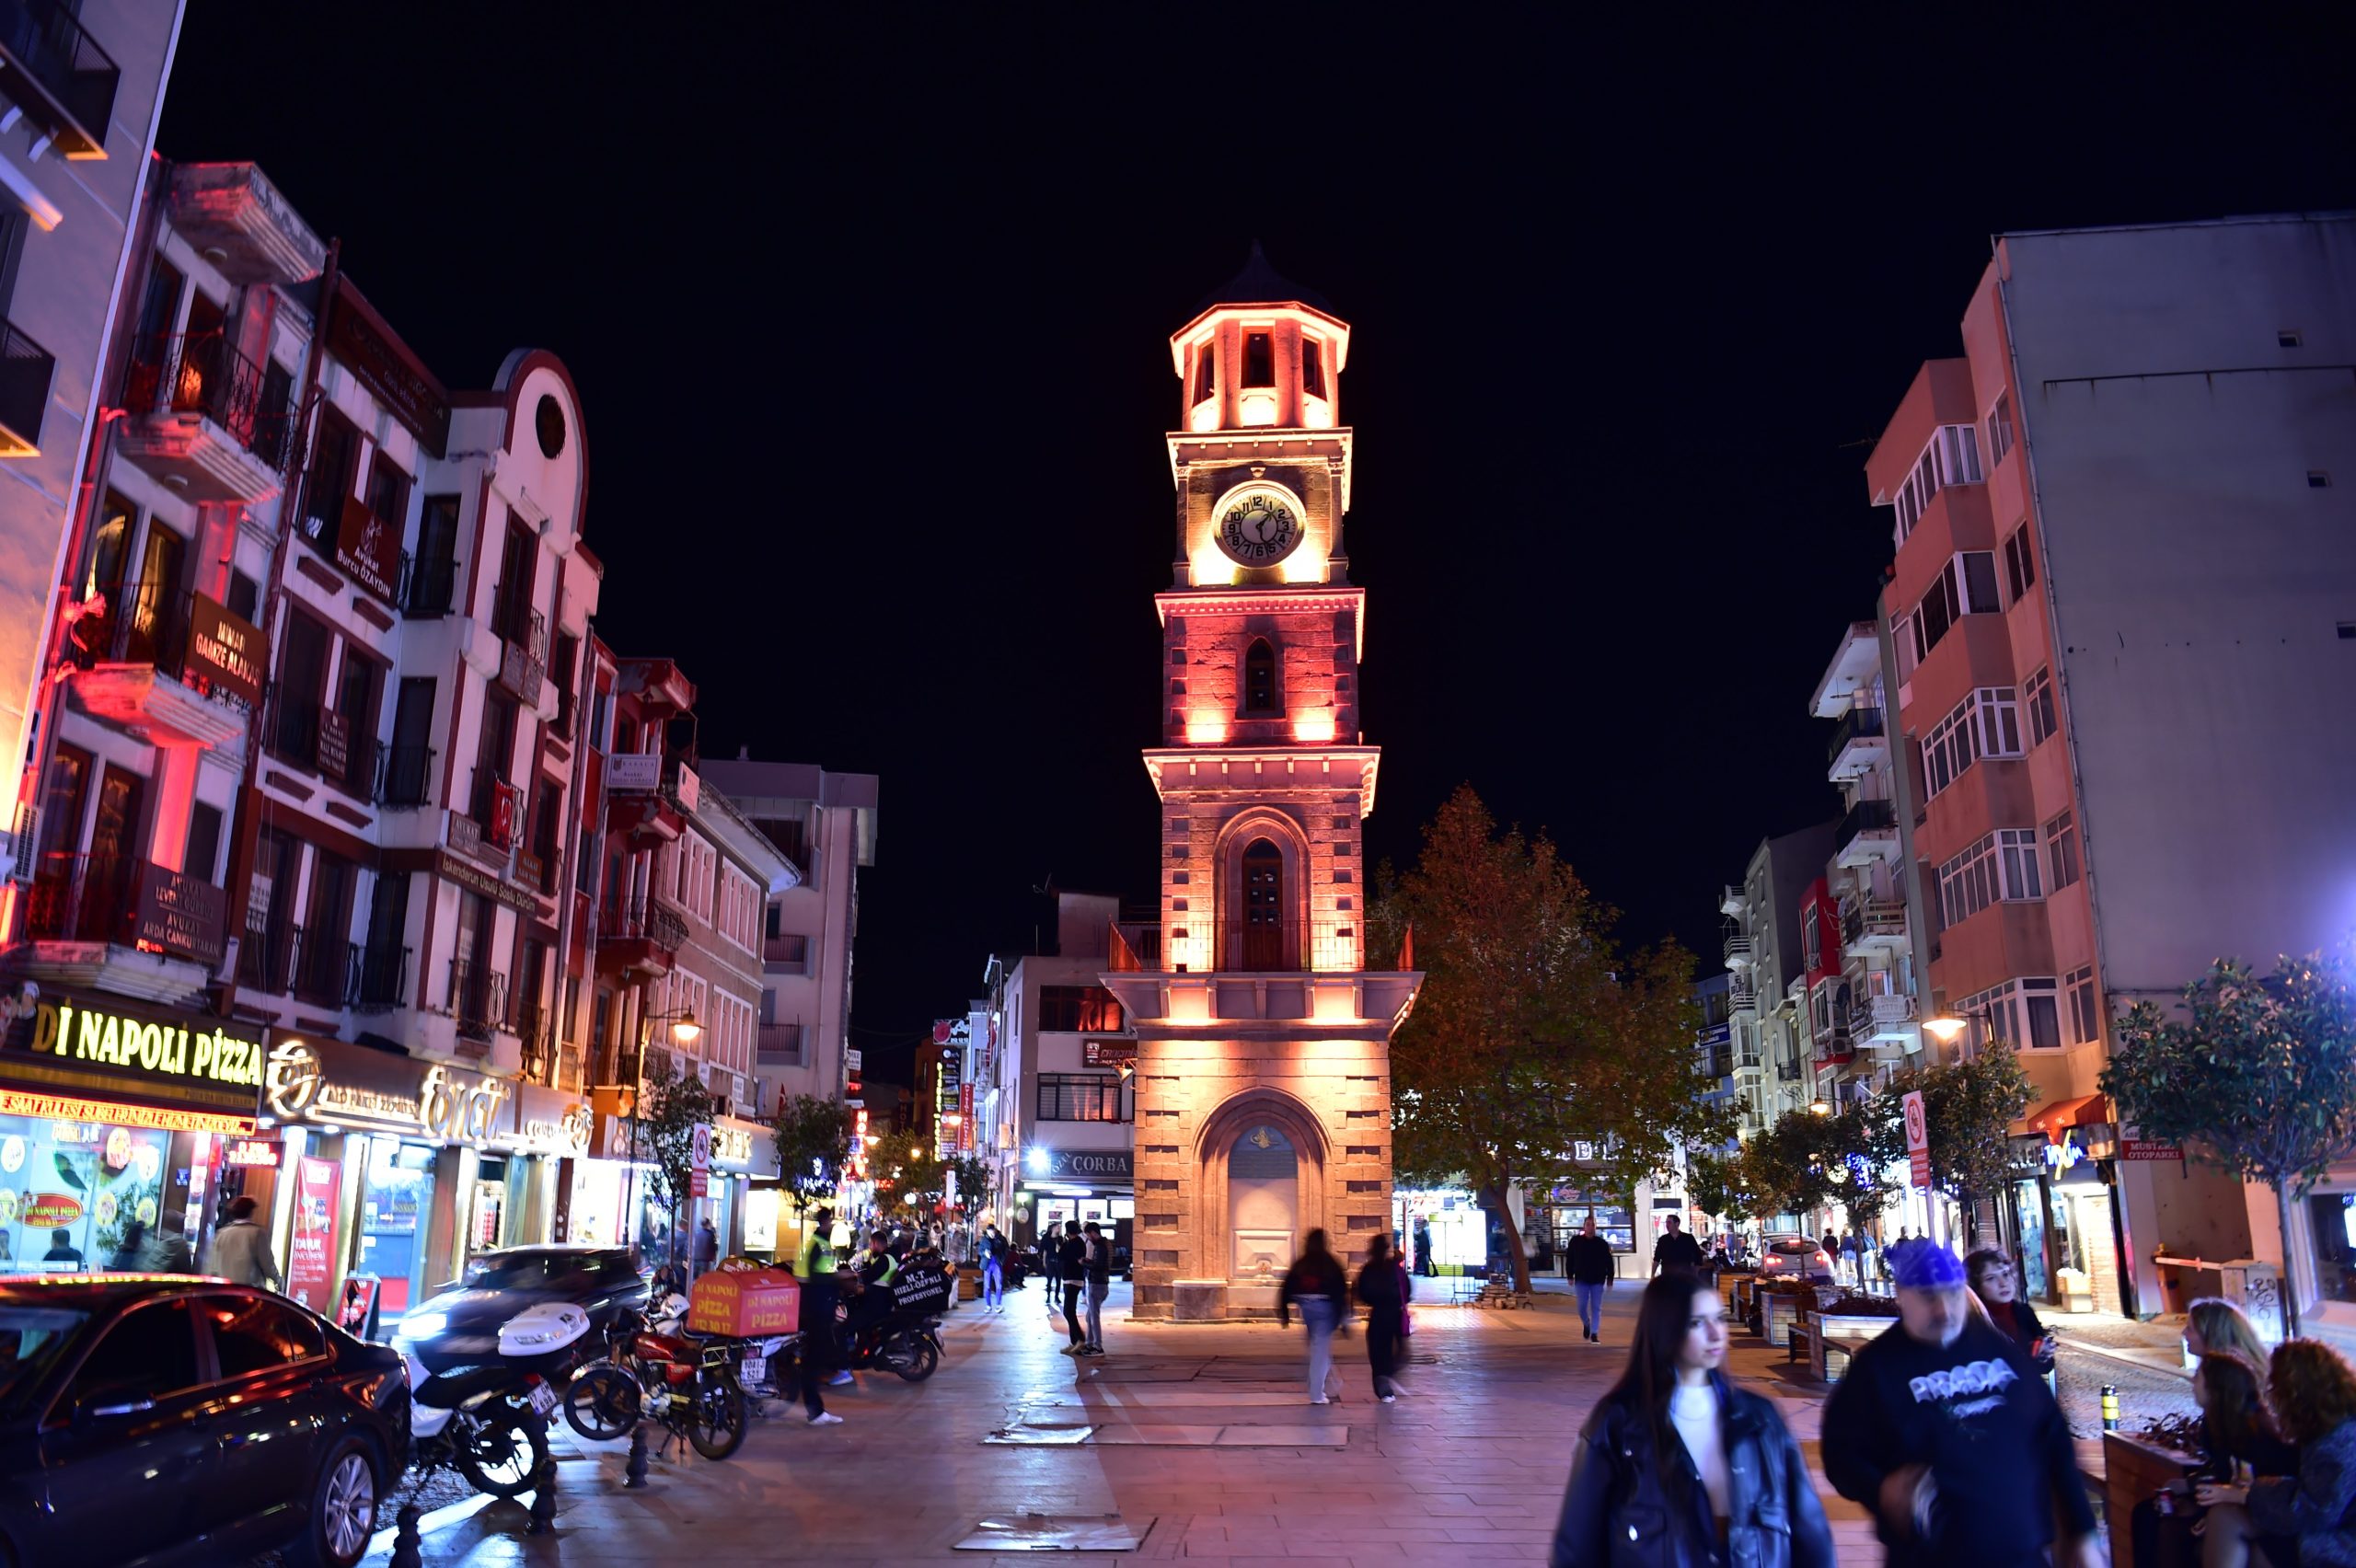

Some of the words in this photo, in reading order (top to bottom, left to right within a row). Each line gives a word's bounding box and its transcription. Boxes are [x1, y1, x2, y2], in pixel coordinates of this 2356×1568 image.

[1253, 497, 1263, 506] 12
[1269, 502, 1273, 510] 1
[1242, 502, 1250, 512] 11
[1230, 512, 1241, 522] 10
[1277, 509, 1286, 518] 2
[1229, 524, 1236, 534] 9
[1282, 521, 1289, 531] 3
[1232, 536, 1240, 546] 8
[1278, 535, 1286, 544] 4
[1243, 544, 1251, 554] 7
[1256, 547, 1263, 556] 6
[1268, 543, 1276, 553] 5
[354, 545, 379, 573] Avukat
[337, 547, 360, 575] Burcu
[360, 564, 391, 598] ÖZAYDIN
[196, 632, 227, 669] GAMZE
[191, 1027, 262, 1086] PİZZA
[1072, 1156, 1127, 1176] ÇORBA
[752, 1309, 788, 1328] PİZZA
